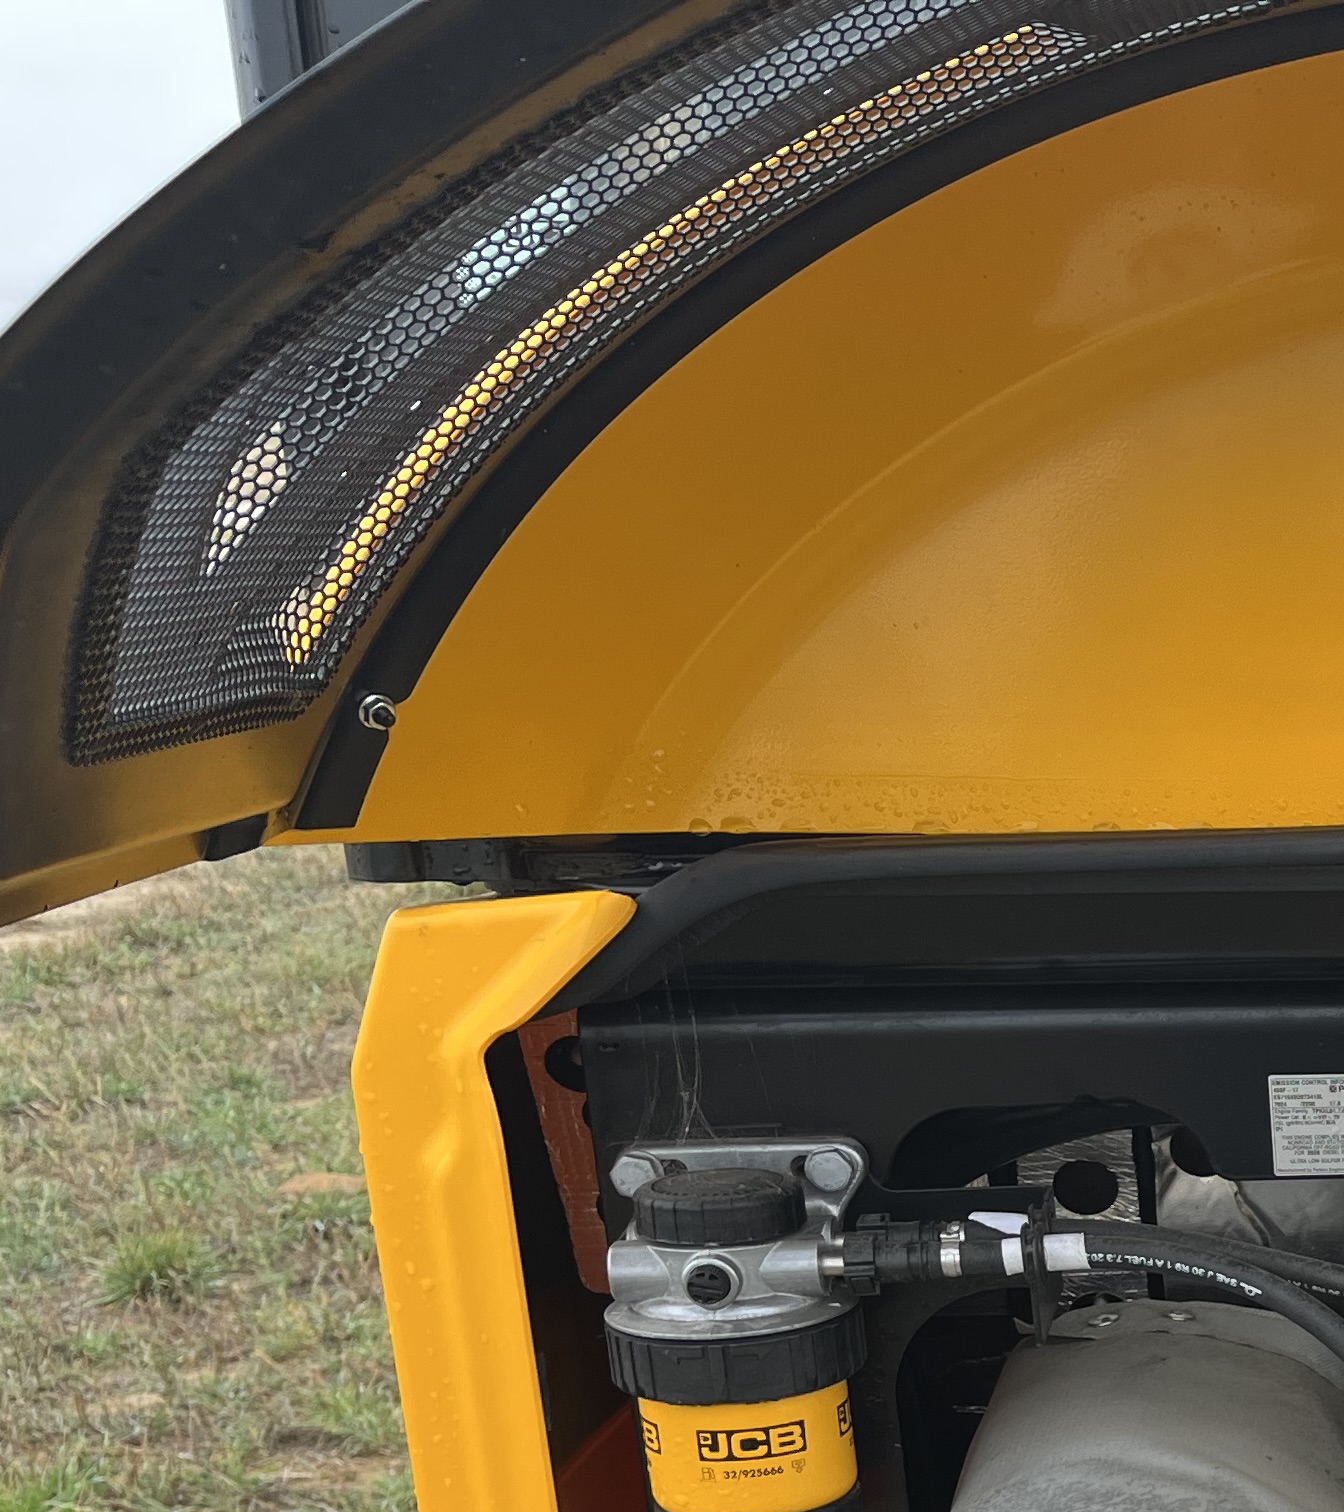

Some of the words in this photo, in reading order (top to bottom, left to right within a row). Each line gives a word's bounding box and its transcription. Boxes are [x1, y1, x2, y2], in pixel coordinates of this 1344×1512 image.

[1105, 1252, 1122, 1263] 7.3
[1124, 1254, 1153, 1266] FUEL
[1154, 1257, 1164, 1267] A
[1190, 1265, 1205, 1277] 30
[1215, 1271, 1237, 1286] SAE
[700, 1423, 805, 1460] JCB
[723, 1465, 784, 1481] 32/925666
